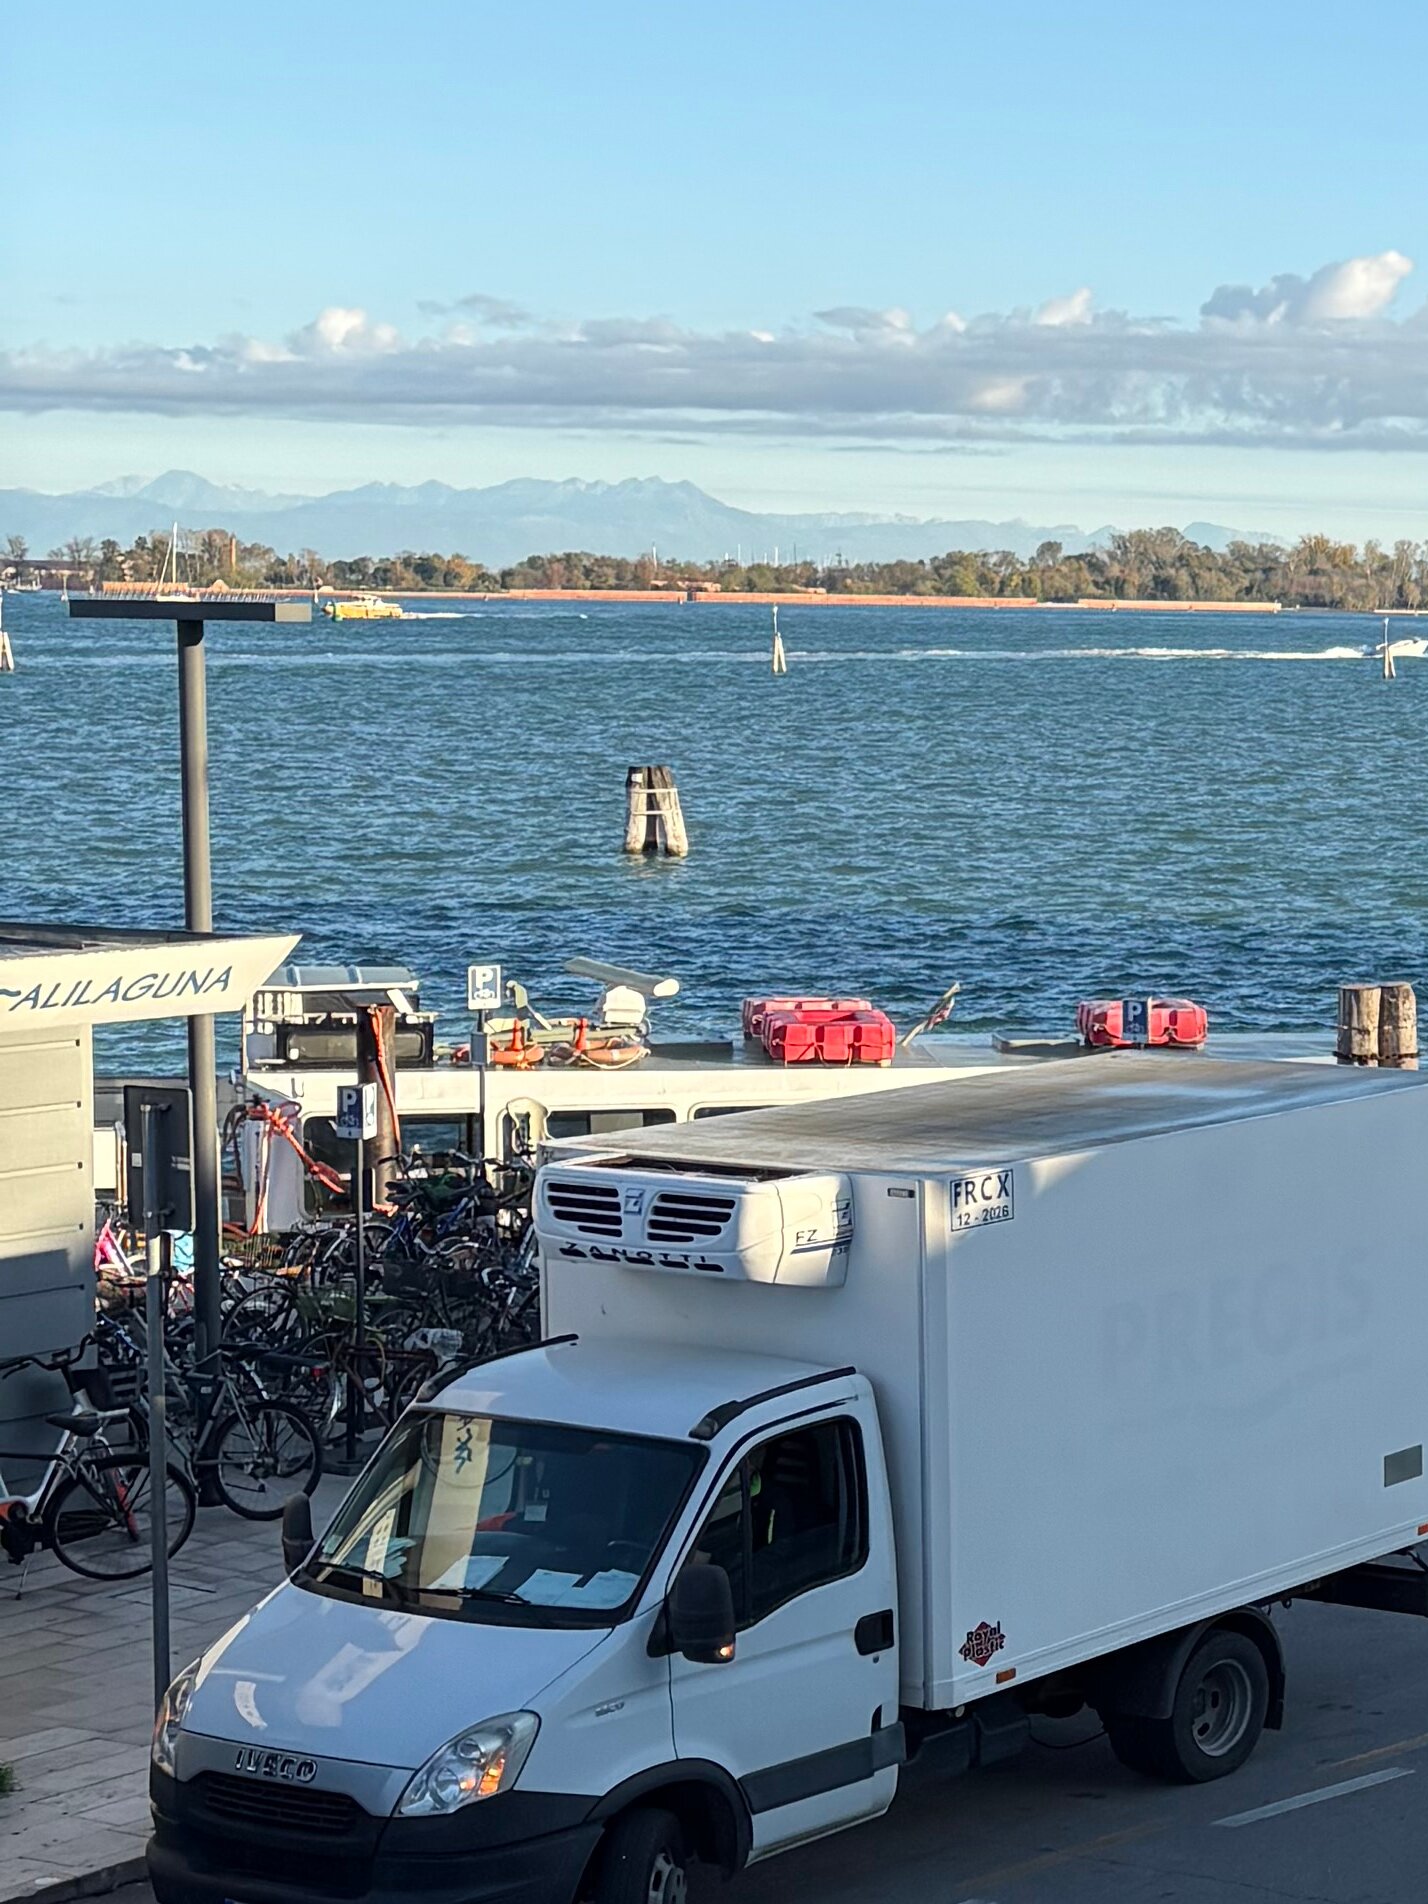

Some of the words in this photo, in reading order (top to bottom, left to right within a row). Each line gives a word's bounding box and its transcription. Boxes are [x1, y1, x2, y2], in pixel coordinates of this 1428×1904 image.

[8, 965, 233, 1012] ALILAGUNA
[475, 968, 493, 989] P
[1128, 1001, 1142, 1022] P
[342, 1088, 357, 1112] P
[954, 1173, 1010, 1208] FRCX
[957, 1212, 971, 1226] 12
[982, 1205, 1009, 1222] 2026
[565, 1241, 707, 1263] ZANOTTI
[235, 1748, 318, 1784] IVECO
